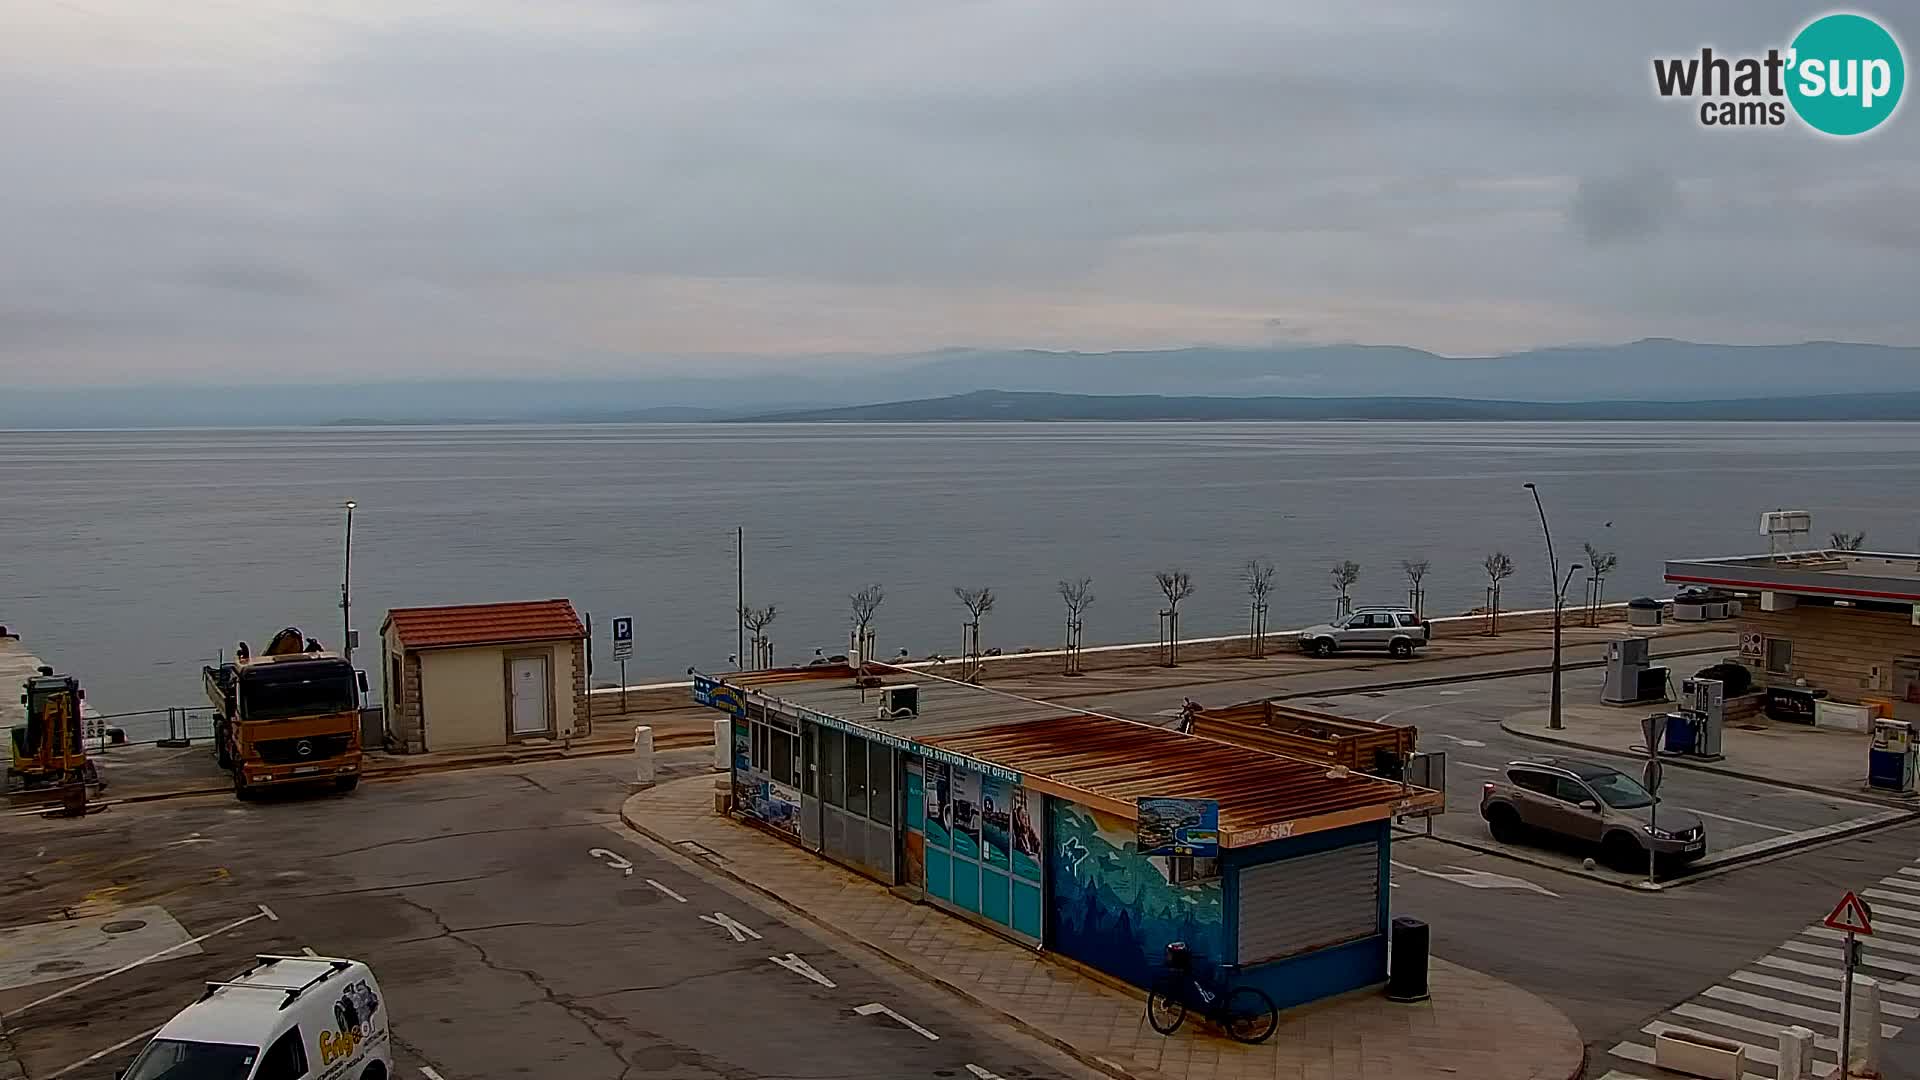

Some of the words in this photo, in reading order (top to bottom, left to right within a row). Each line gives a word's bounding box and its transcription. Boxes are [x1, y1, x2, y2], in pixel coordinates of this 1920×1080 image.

[617, 621, 628, 638] P
[881, 733, 911, 751] POSTAJA
[934, 748, 965, 767] STATION
[966, 759, 991, 775] TICKET
[992, 766, 1018, 782] OFFICE
